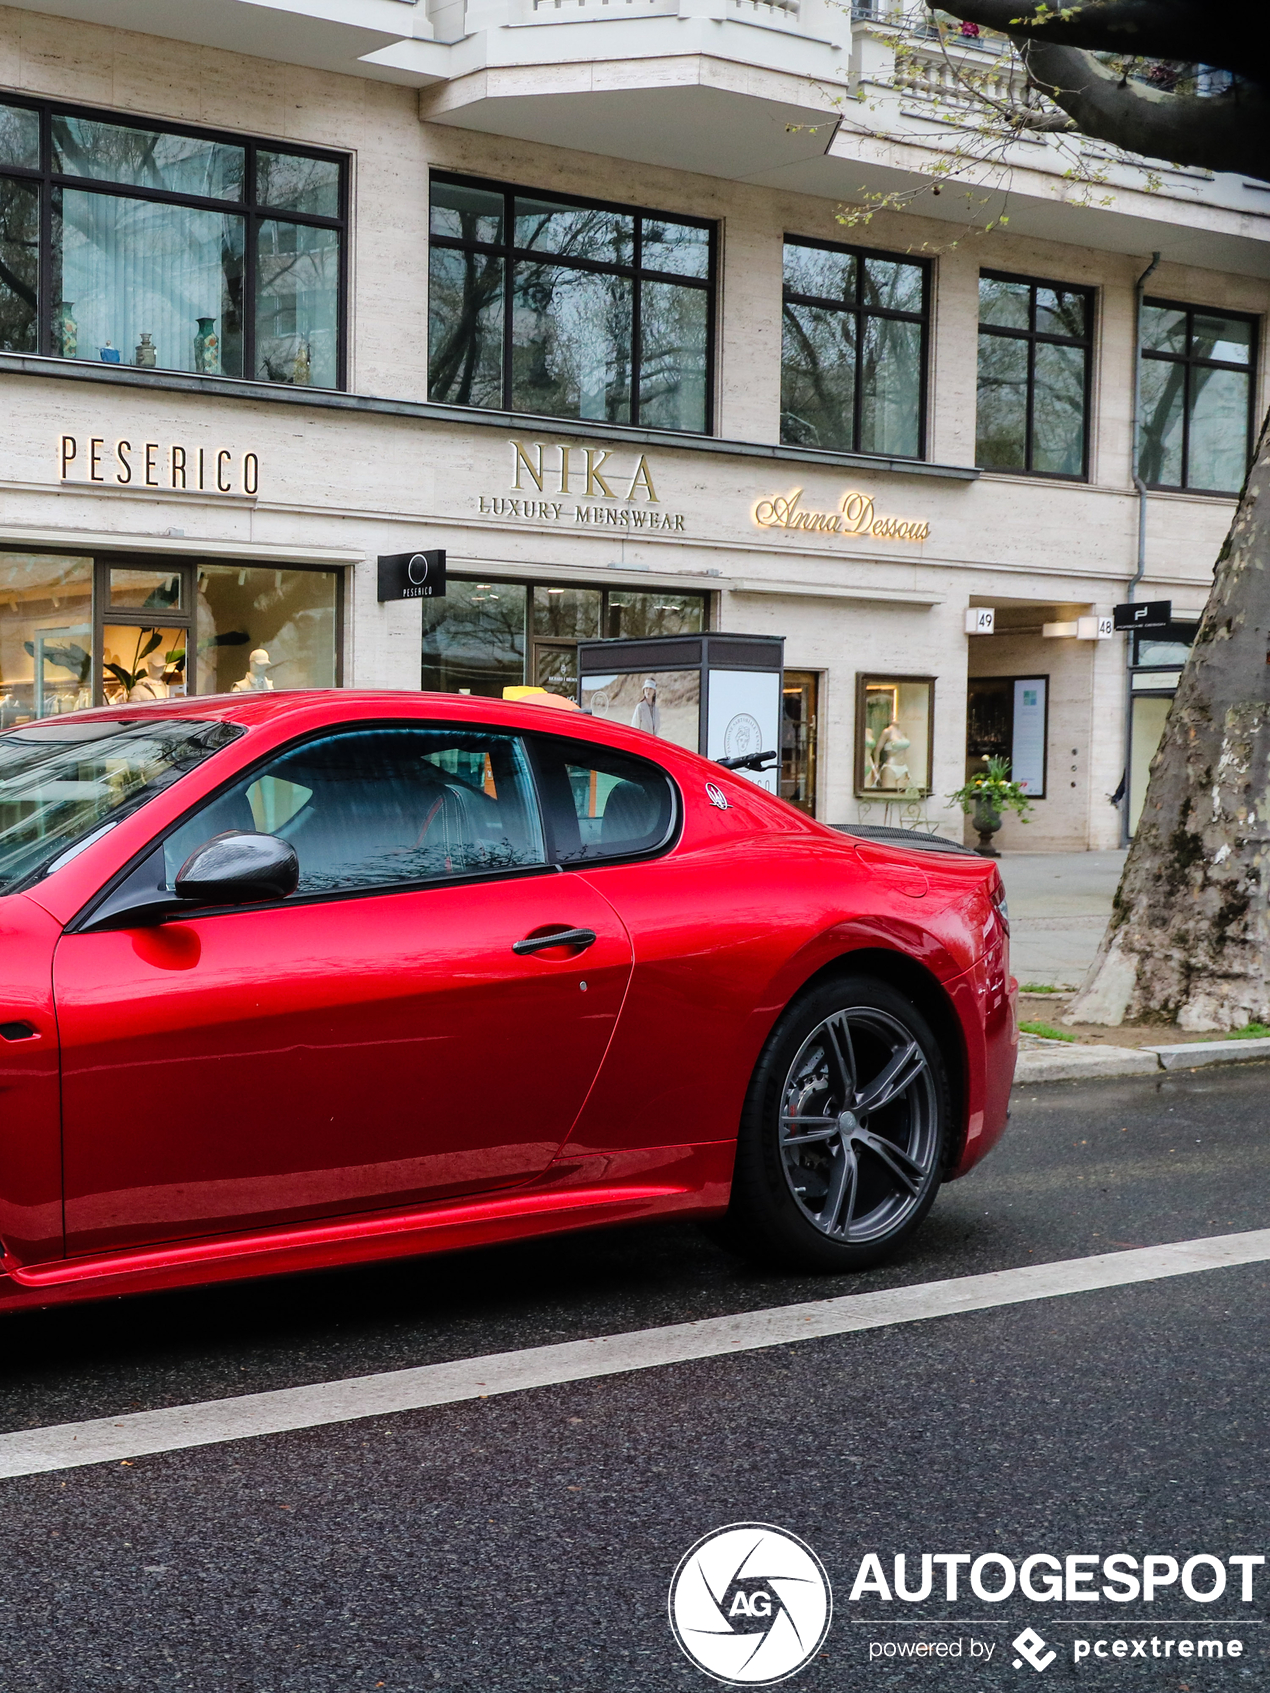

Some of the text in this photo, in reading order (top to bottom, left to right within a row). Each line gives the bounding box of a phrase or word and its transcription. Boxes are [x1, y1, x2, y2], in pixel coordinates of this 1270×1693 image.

[61, 435, 259, 495] PESERICO
[509, 440, 661, 503] NIKA
[479, 496, 686, 531] LUXURY MENSWEAR
[755, 488, 931, 540] Anna Dessous
[403, 586, 433, 598] PESERICO
[978, 613, 993, 628] 49
[1099, 620, 1112, 634] 48
